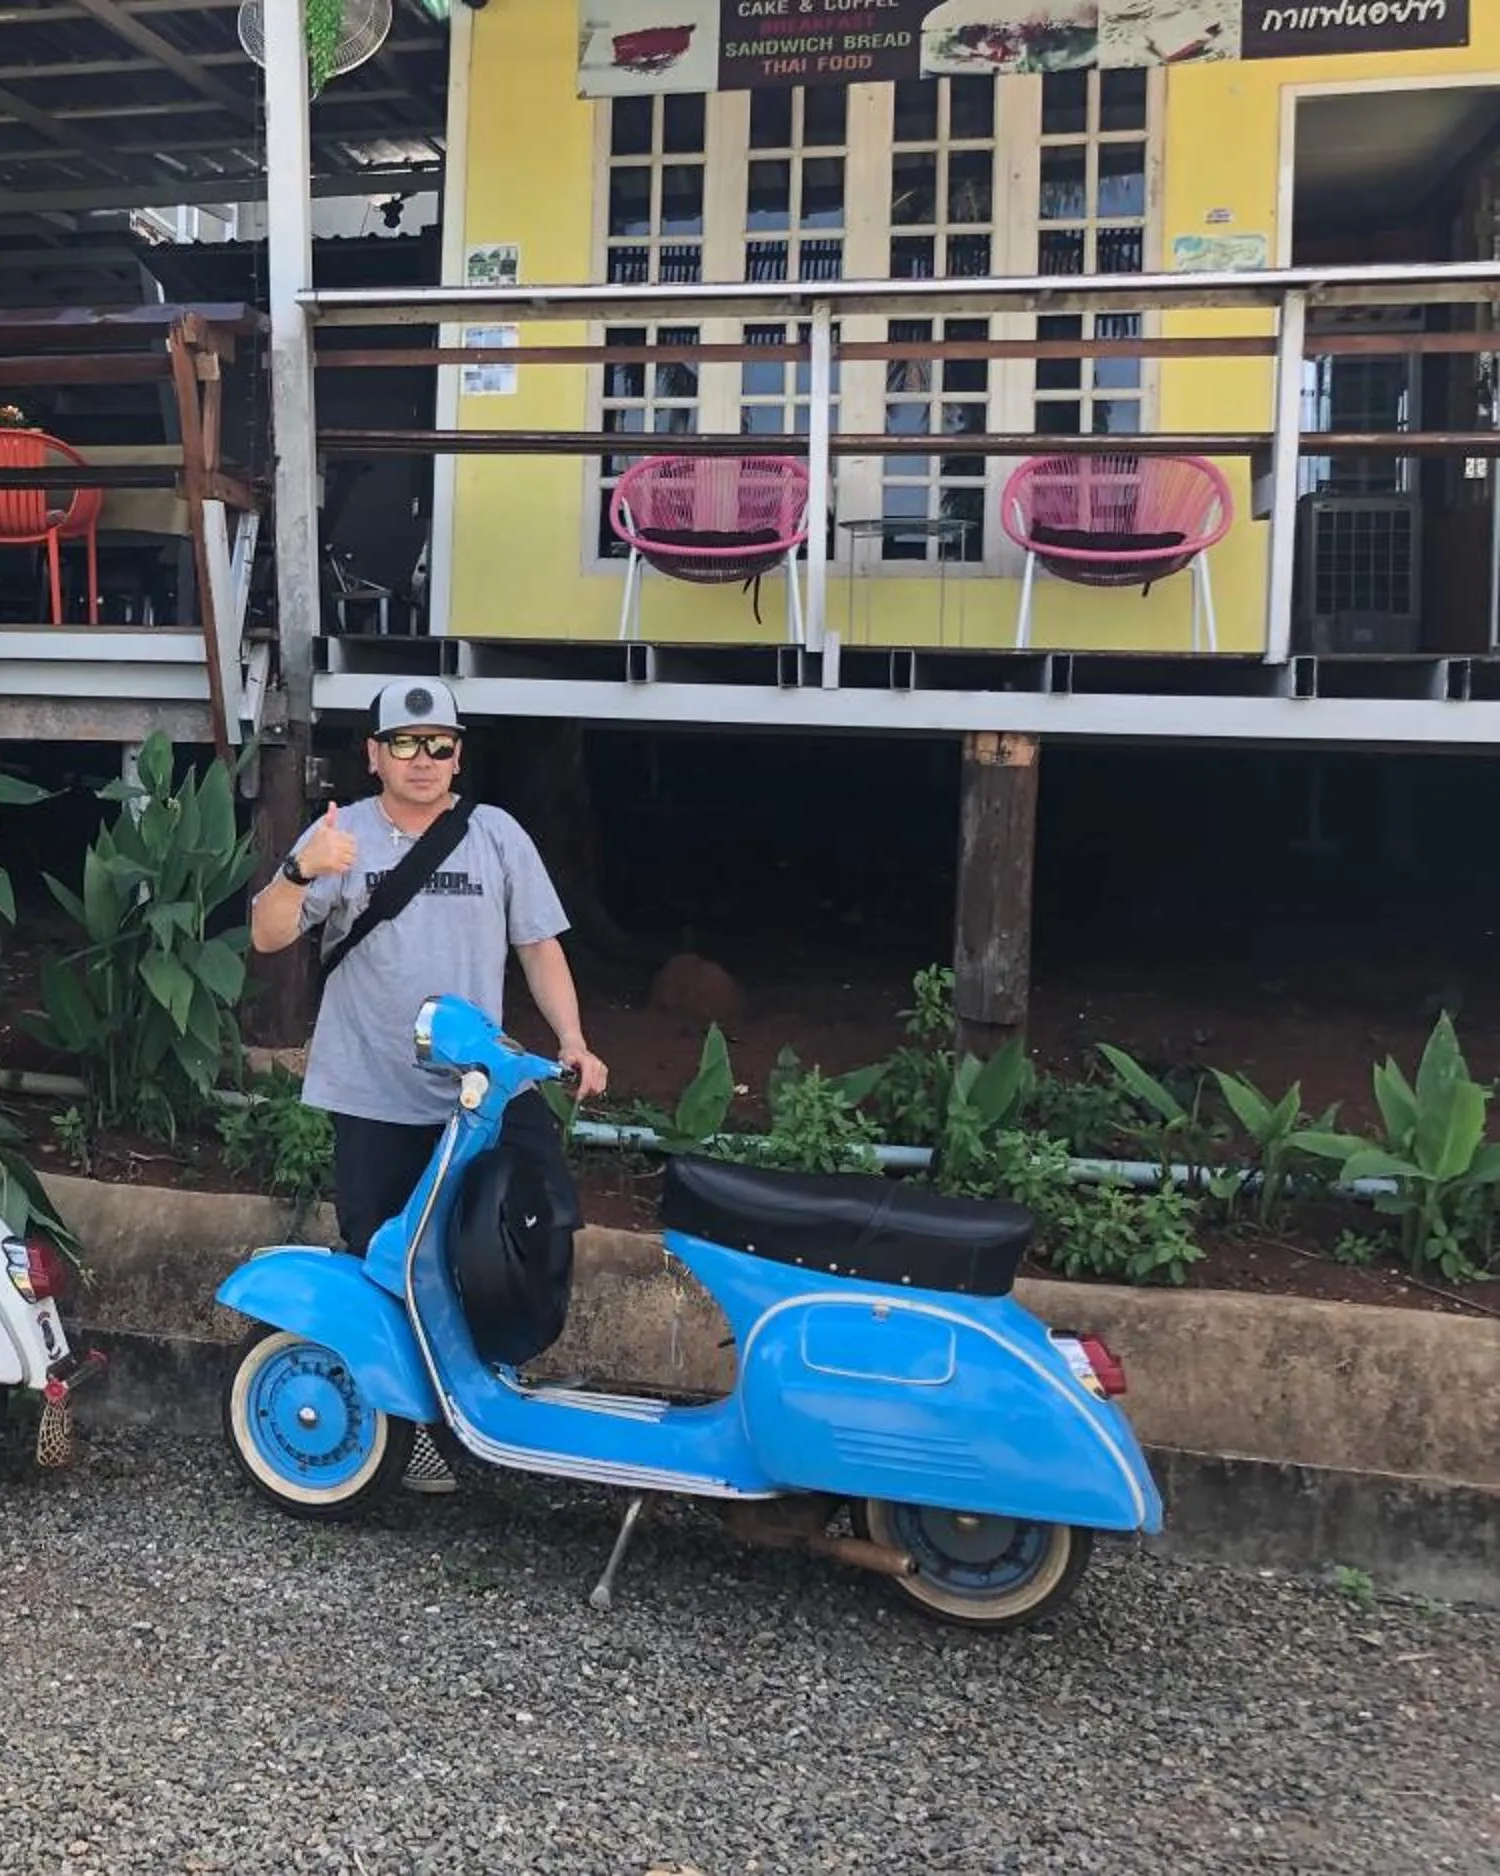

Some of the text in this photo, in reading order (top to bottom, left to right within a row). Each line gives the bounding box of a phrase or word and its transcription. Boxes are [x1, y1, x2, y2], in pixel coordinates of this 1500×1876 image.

[738, 0, 789, 17] CAKE
[725, 31, 912, 57] SANDWICH BREAD
[762, 54, 873, 75] THAI FOOD
